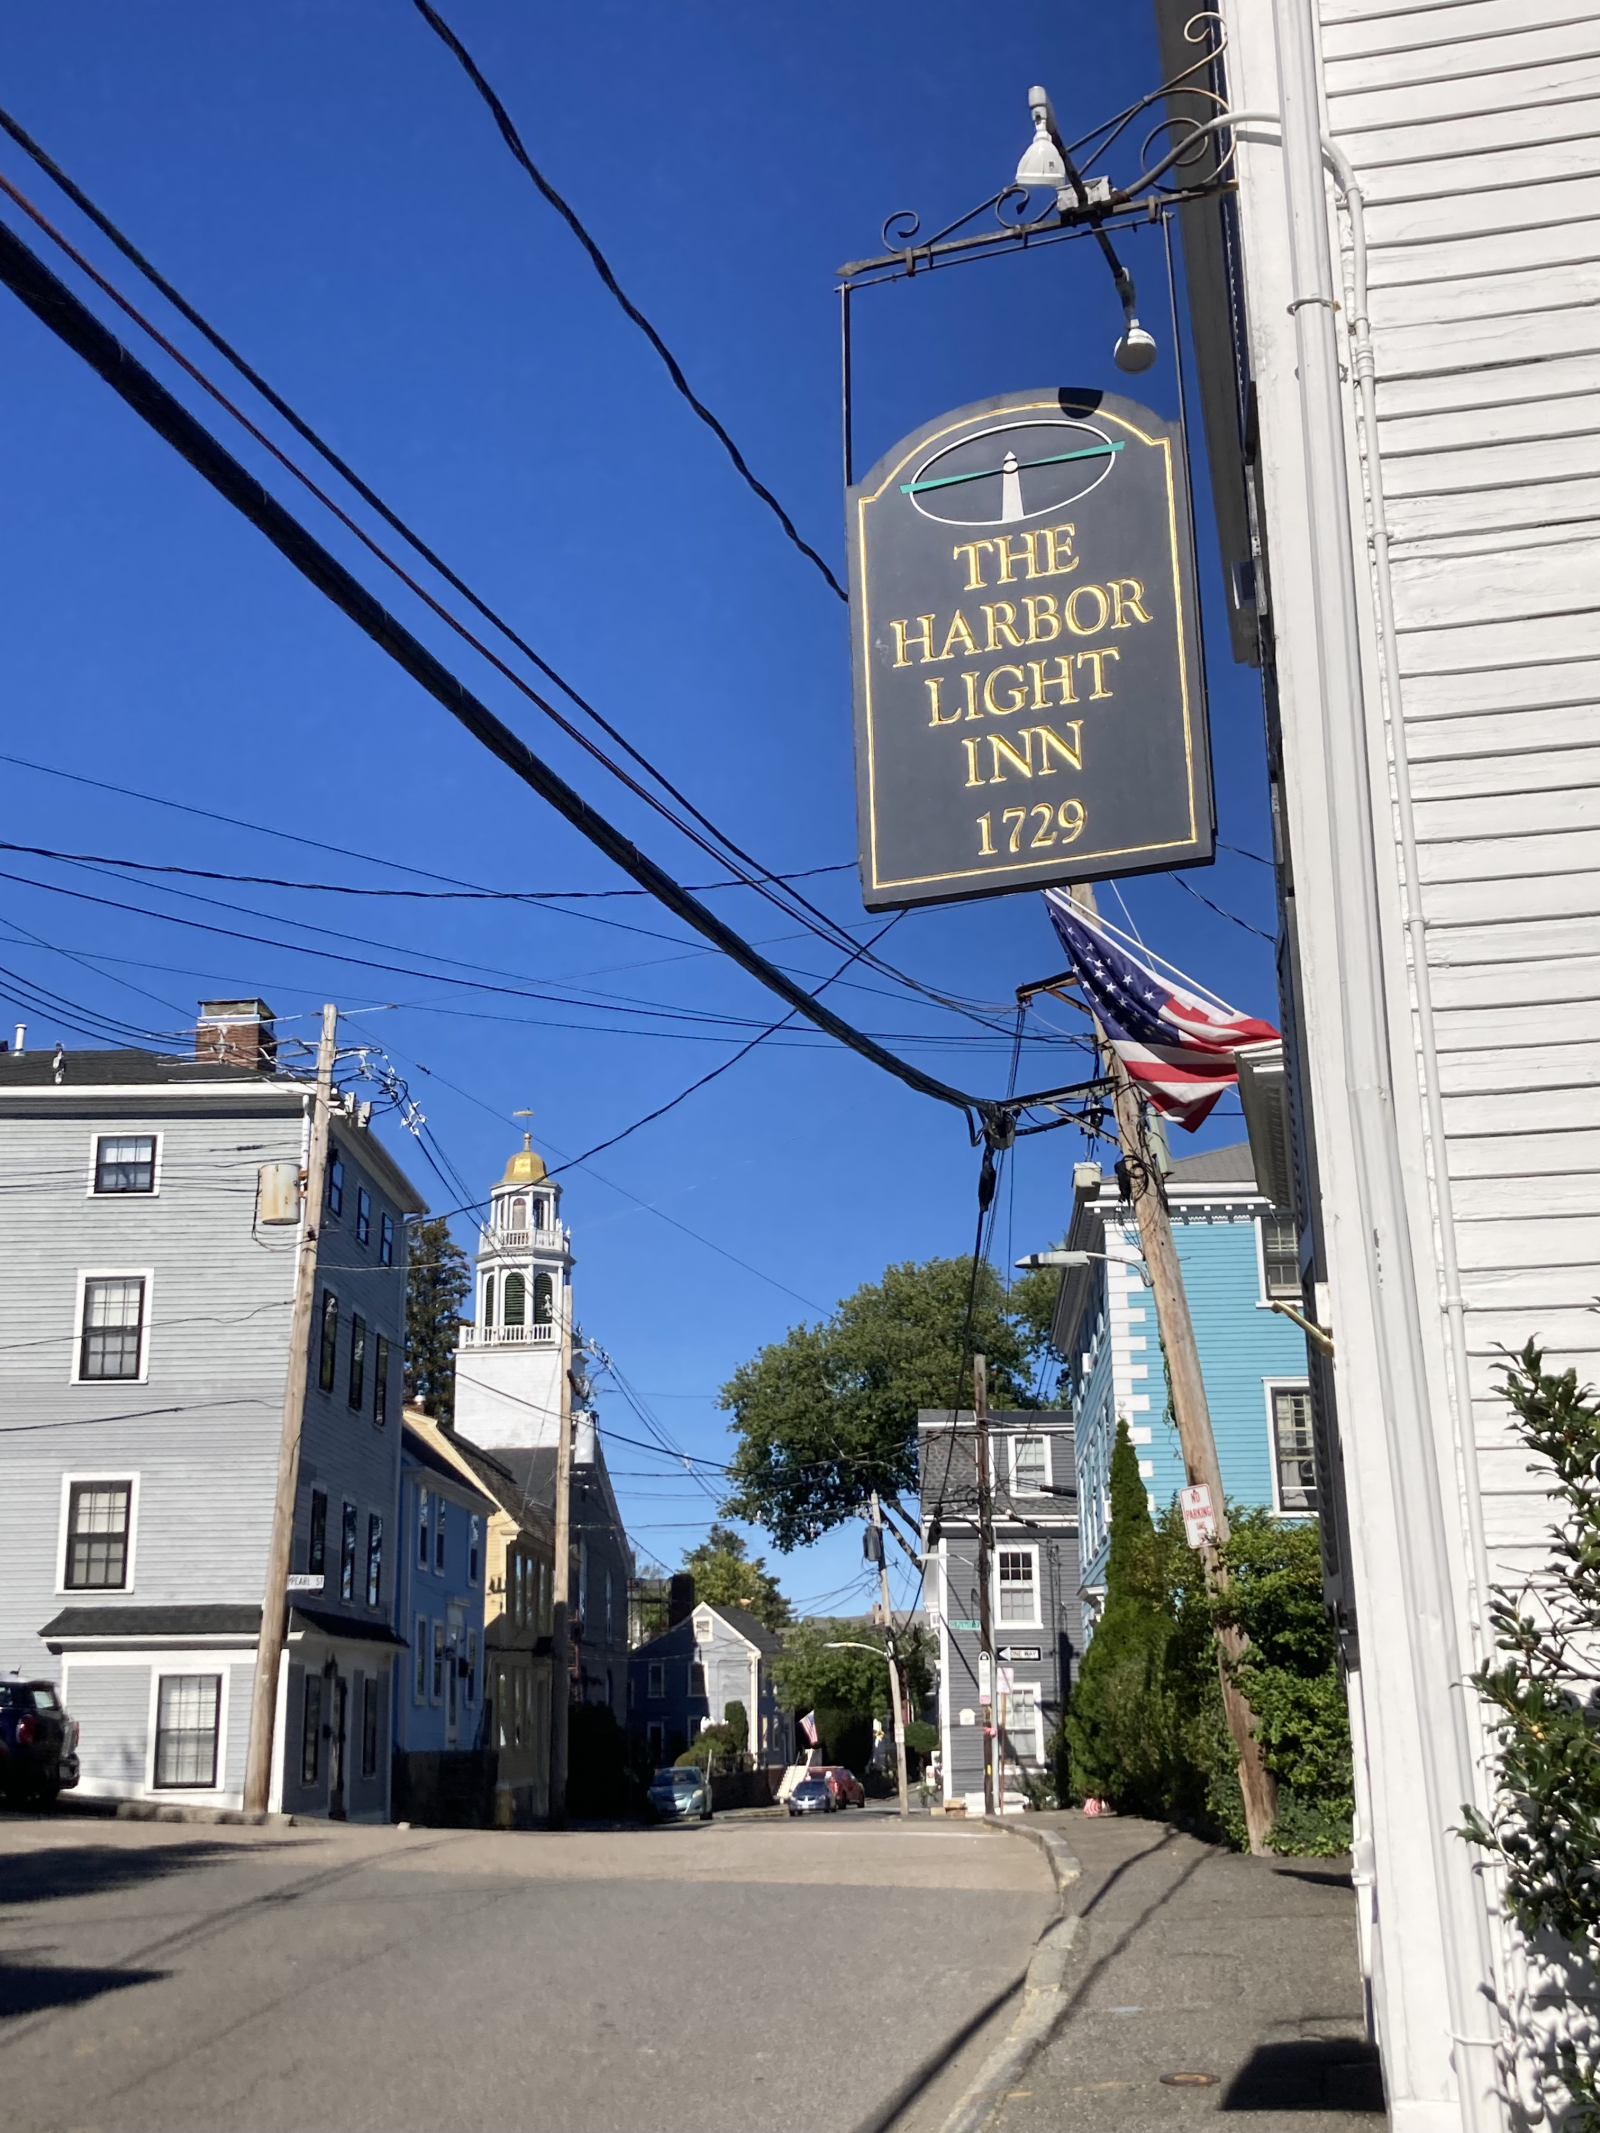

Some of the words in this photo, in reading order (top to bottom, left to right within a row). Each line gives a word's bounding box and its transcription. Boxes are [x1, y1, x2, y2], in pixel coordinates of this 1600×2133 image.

[954, 523, 1079, 591] THE
[889, 577, 1153, 668] HARBOR
[924, 646, 1121, 728] LIGHT
[961, 719, 1084, 788] INN
[976, 798, 1088, 857] 1729
[1185, 1506, 1212, 1520] PARKING
[1191, 1491, 1200, 1503] NO
